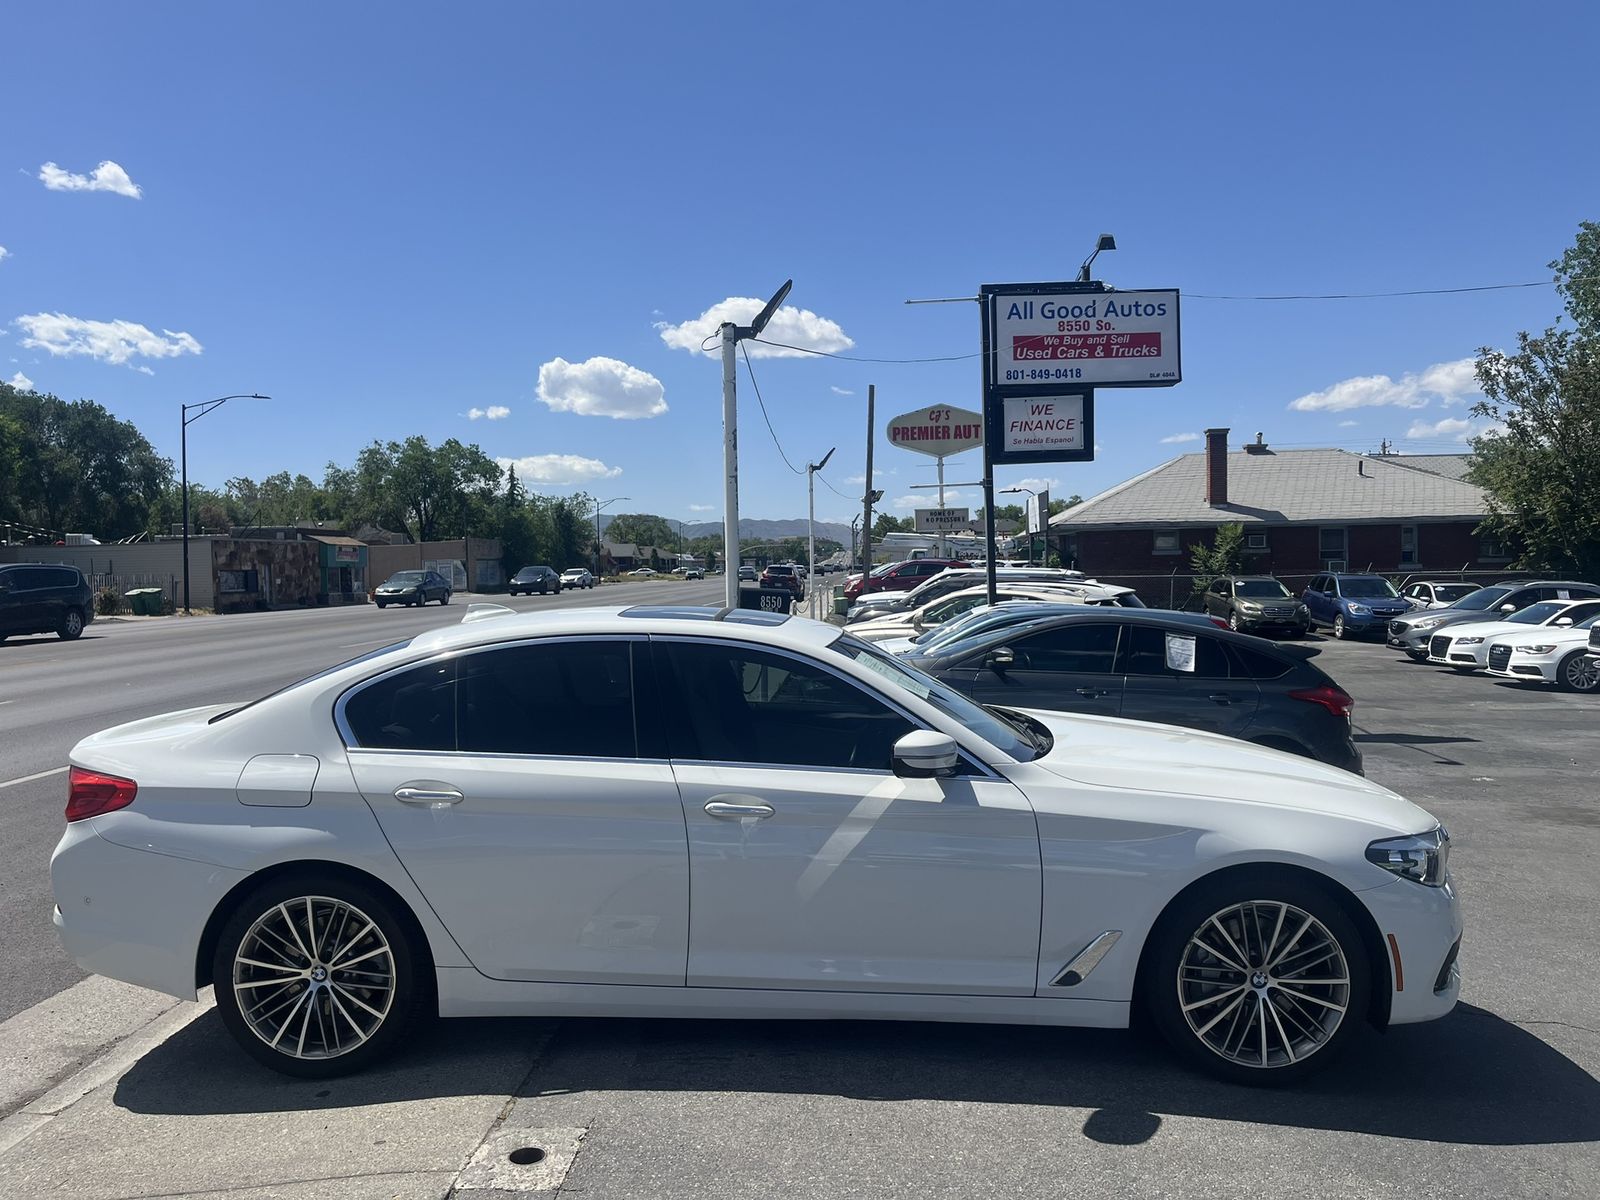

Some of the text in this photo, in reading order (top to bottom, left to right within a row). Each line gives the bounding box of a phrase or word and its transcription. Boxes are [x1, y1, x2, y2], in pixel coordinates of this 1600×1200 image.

[1007, 300, 1167, 320] All Good Autos
[1058, 319, 1115, 332] 8550 So.
[1043, 334, 1130, 347] We Buy and Sell
[1016, 344, 1158, 359] Used Cars & Trucks
[1006, 368, 1082, 380] 801-849-0418
[1031, 404, 1054, 415] WE
[1010, 418, 1076, 432] FINANCE
[892, 424, 982, 442] PREMIER AUT
[760, 595, 782, 608] 8550
